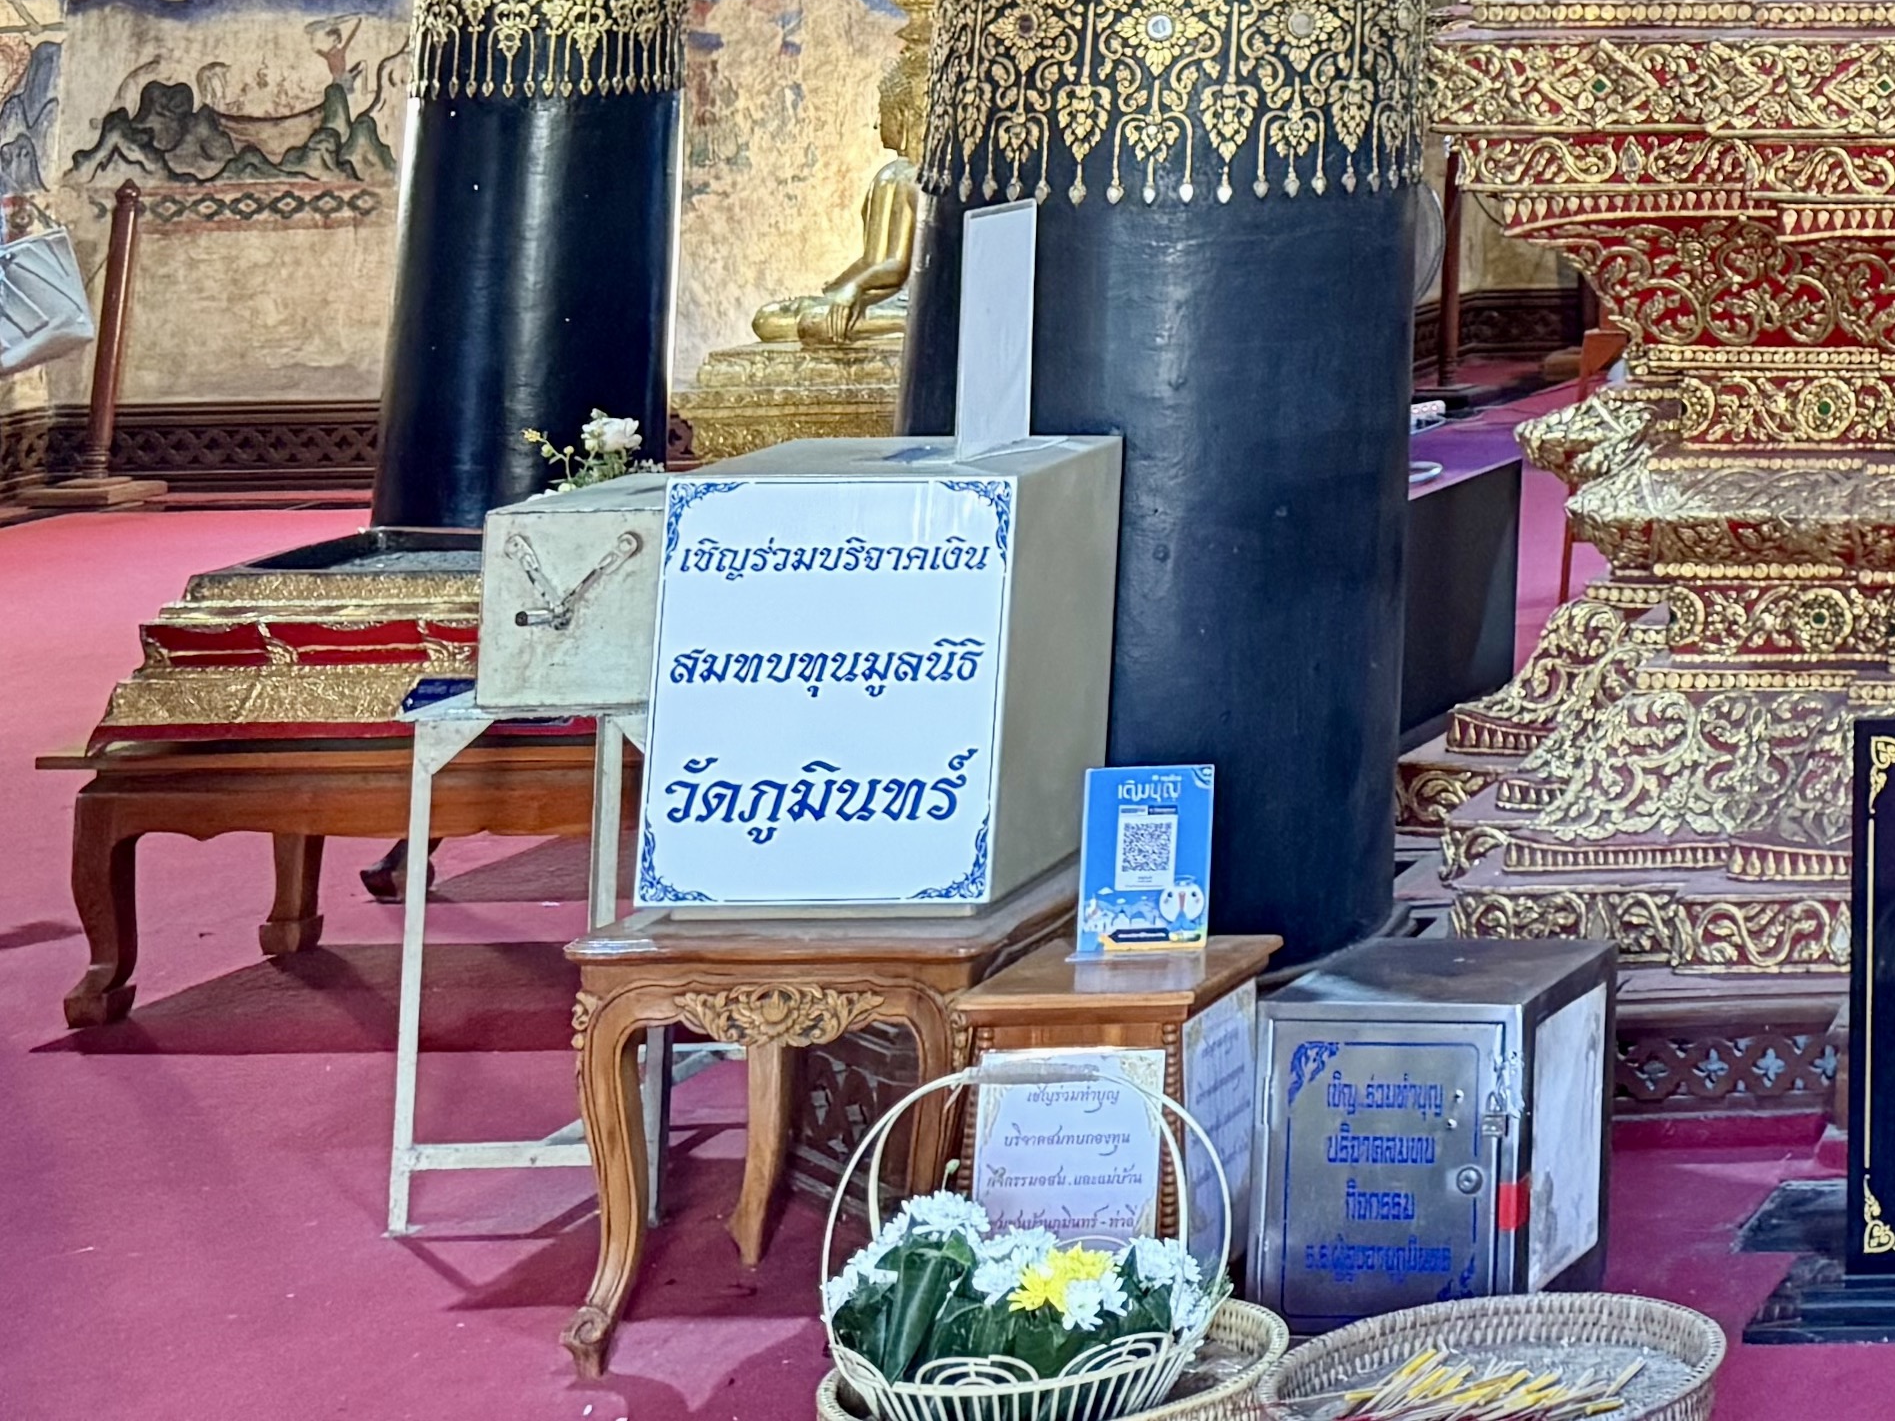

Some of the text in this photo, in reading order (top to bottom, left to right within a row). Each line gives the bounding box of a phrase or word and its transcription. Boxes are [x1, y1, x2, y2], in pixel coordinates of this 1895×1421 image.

[678, 534, 990, 581] เชิญร่วมบริจาคเงิน
[669, 639, 984, 696] สมทบทุนมูลนิธิ
[663, 747, 979, 844] วัดภูมินทร์
[1345, 1177, 1416, 1221] กิจกรรม
